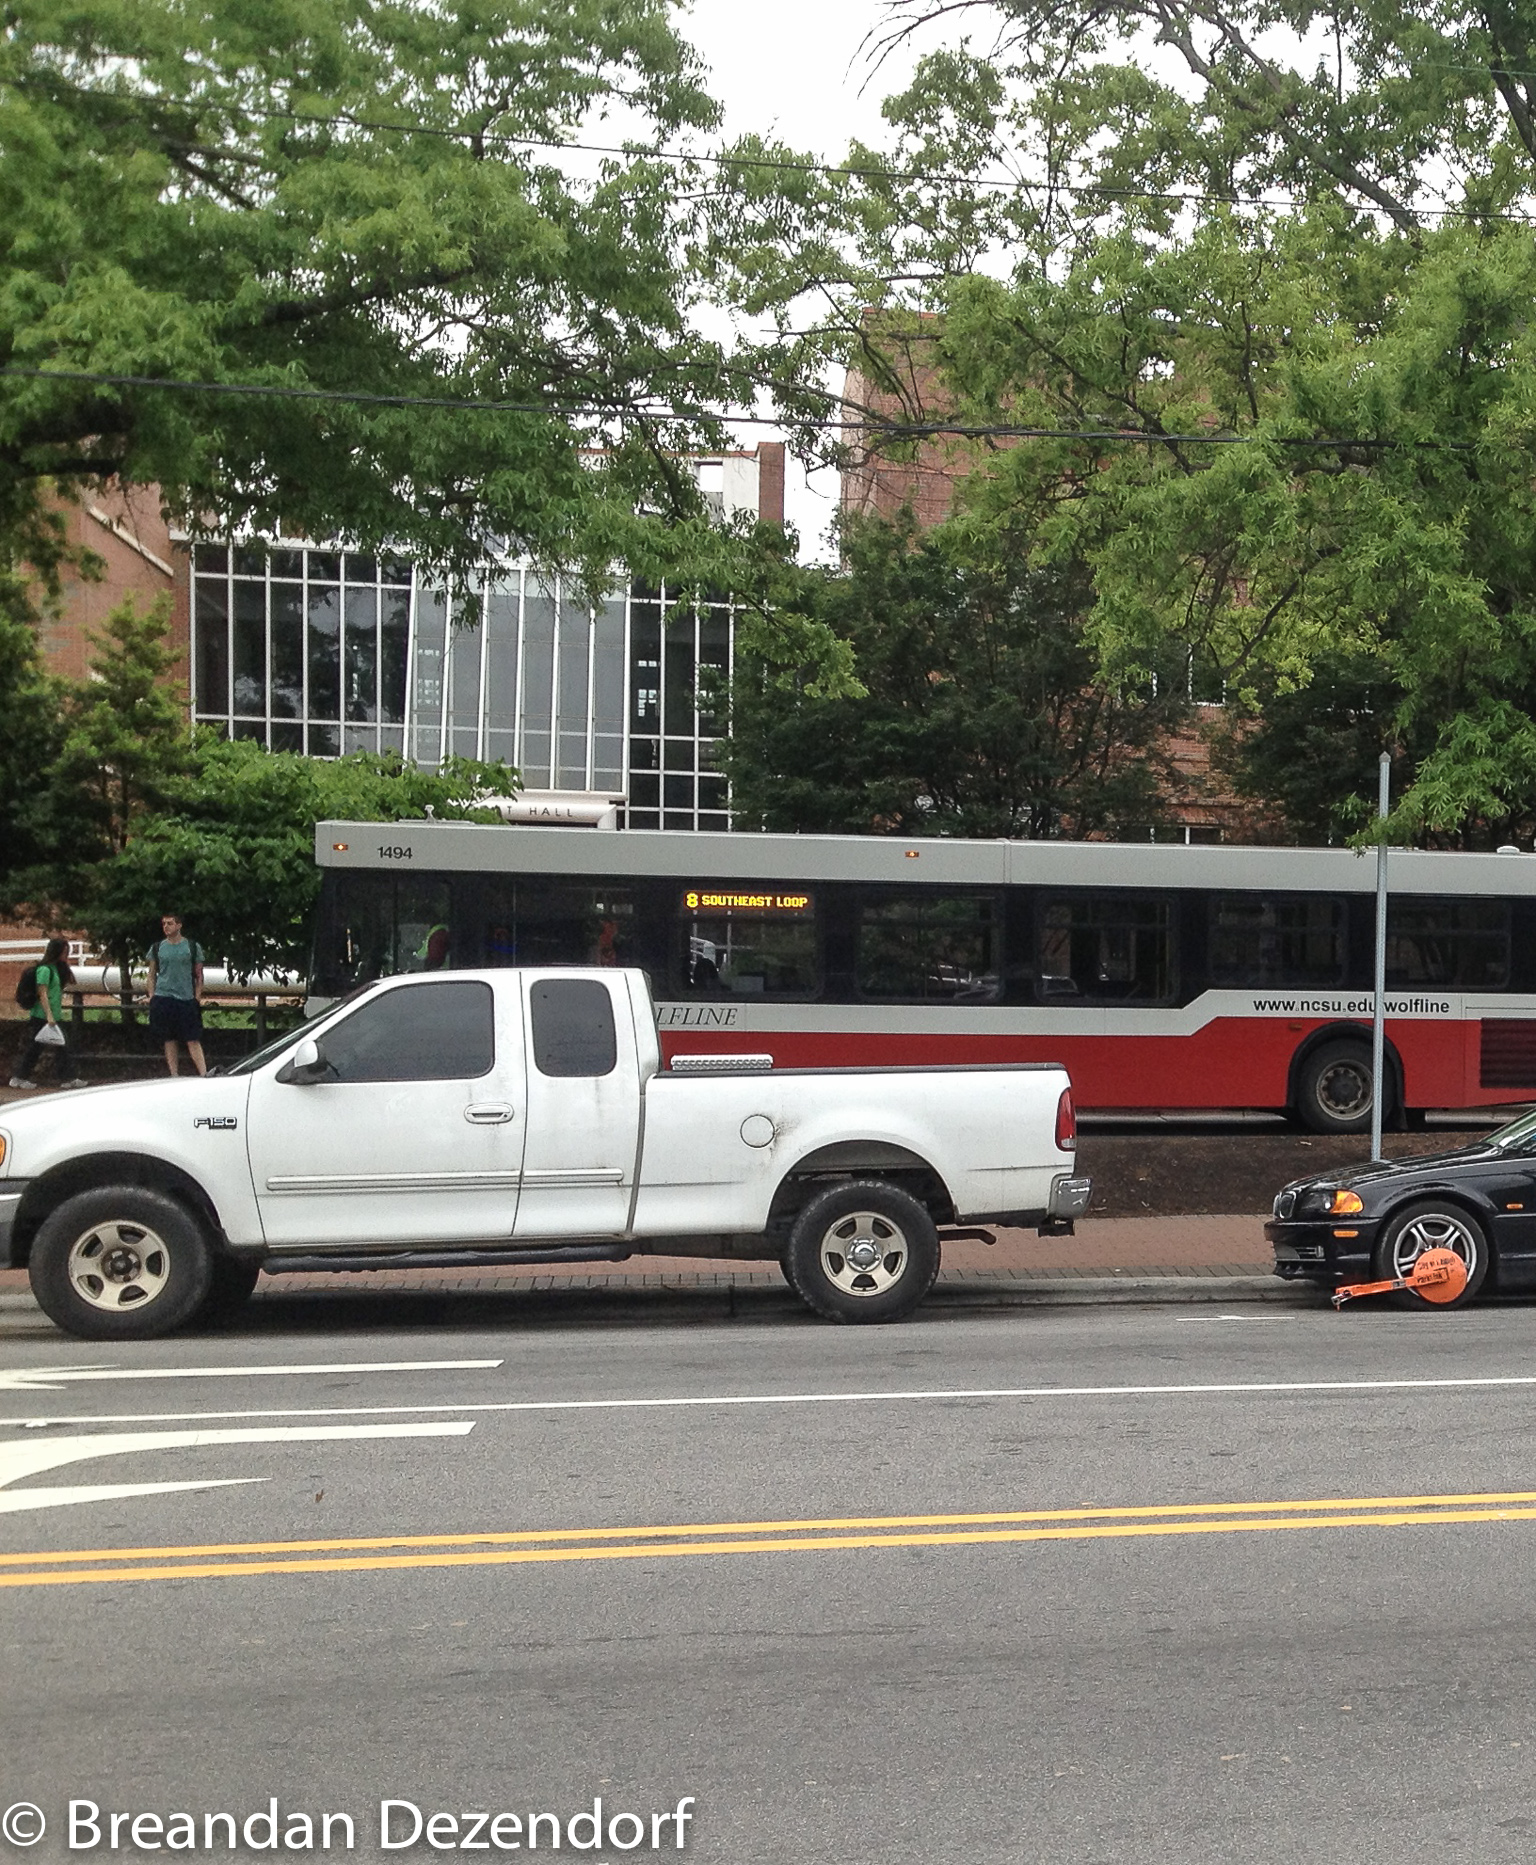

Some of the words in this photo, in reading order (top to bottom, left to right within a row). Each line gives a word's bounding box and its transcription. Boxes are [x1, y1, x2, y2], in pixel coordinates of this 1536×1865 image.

[529, 807, 573, 817] HALL
[377, 846, 413, 859] 1494
[686, 893, 699, 907] 8
[701, 895, 773, 907] SOUTHEAST
[776, 896, 808, 908] LOOP
[1253, 998, 1450, 1014] www.ncsu.eduwolfline
[656, 1007, 738, 1025] LFLINE
